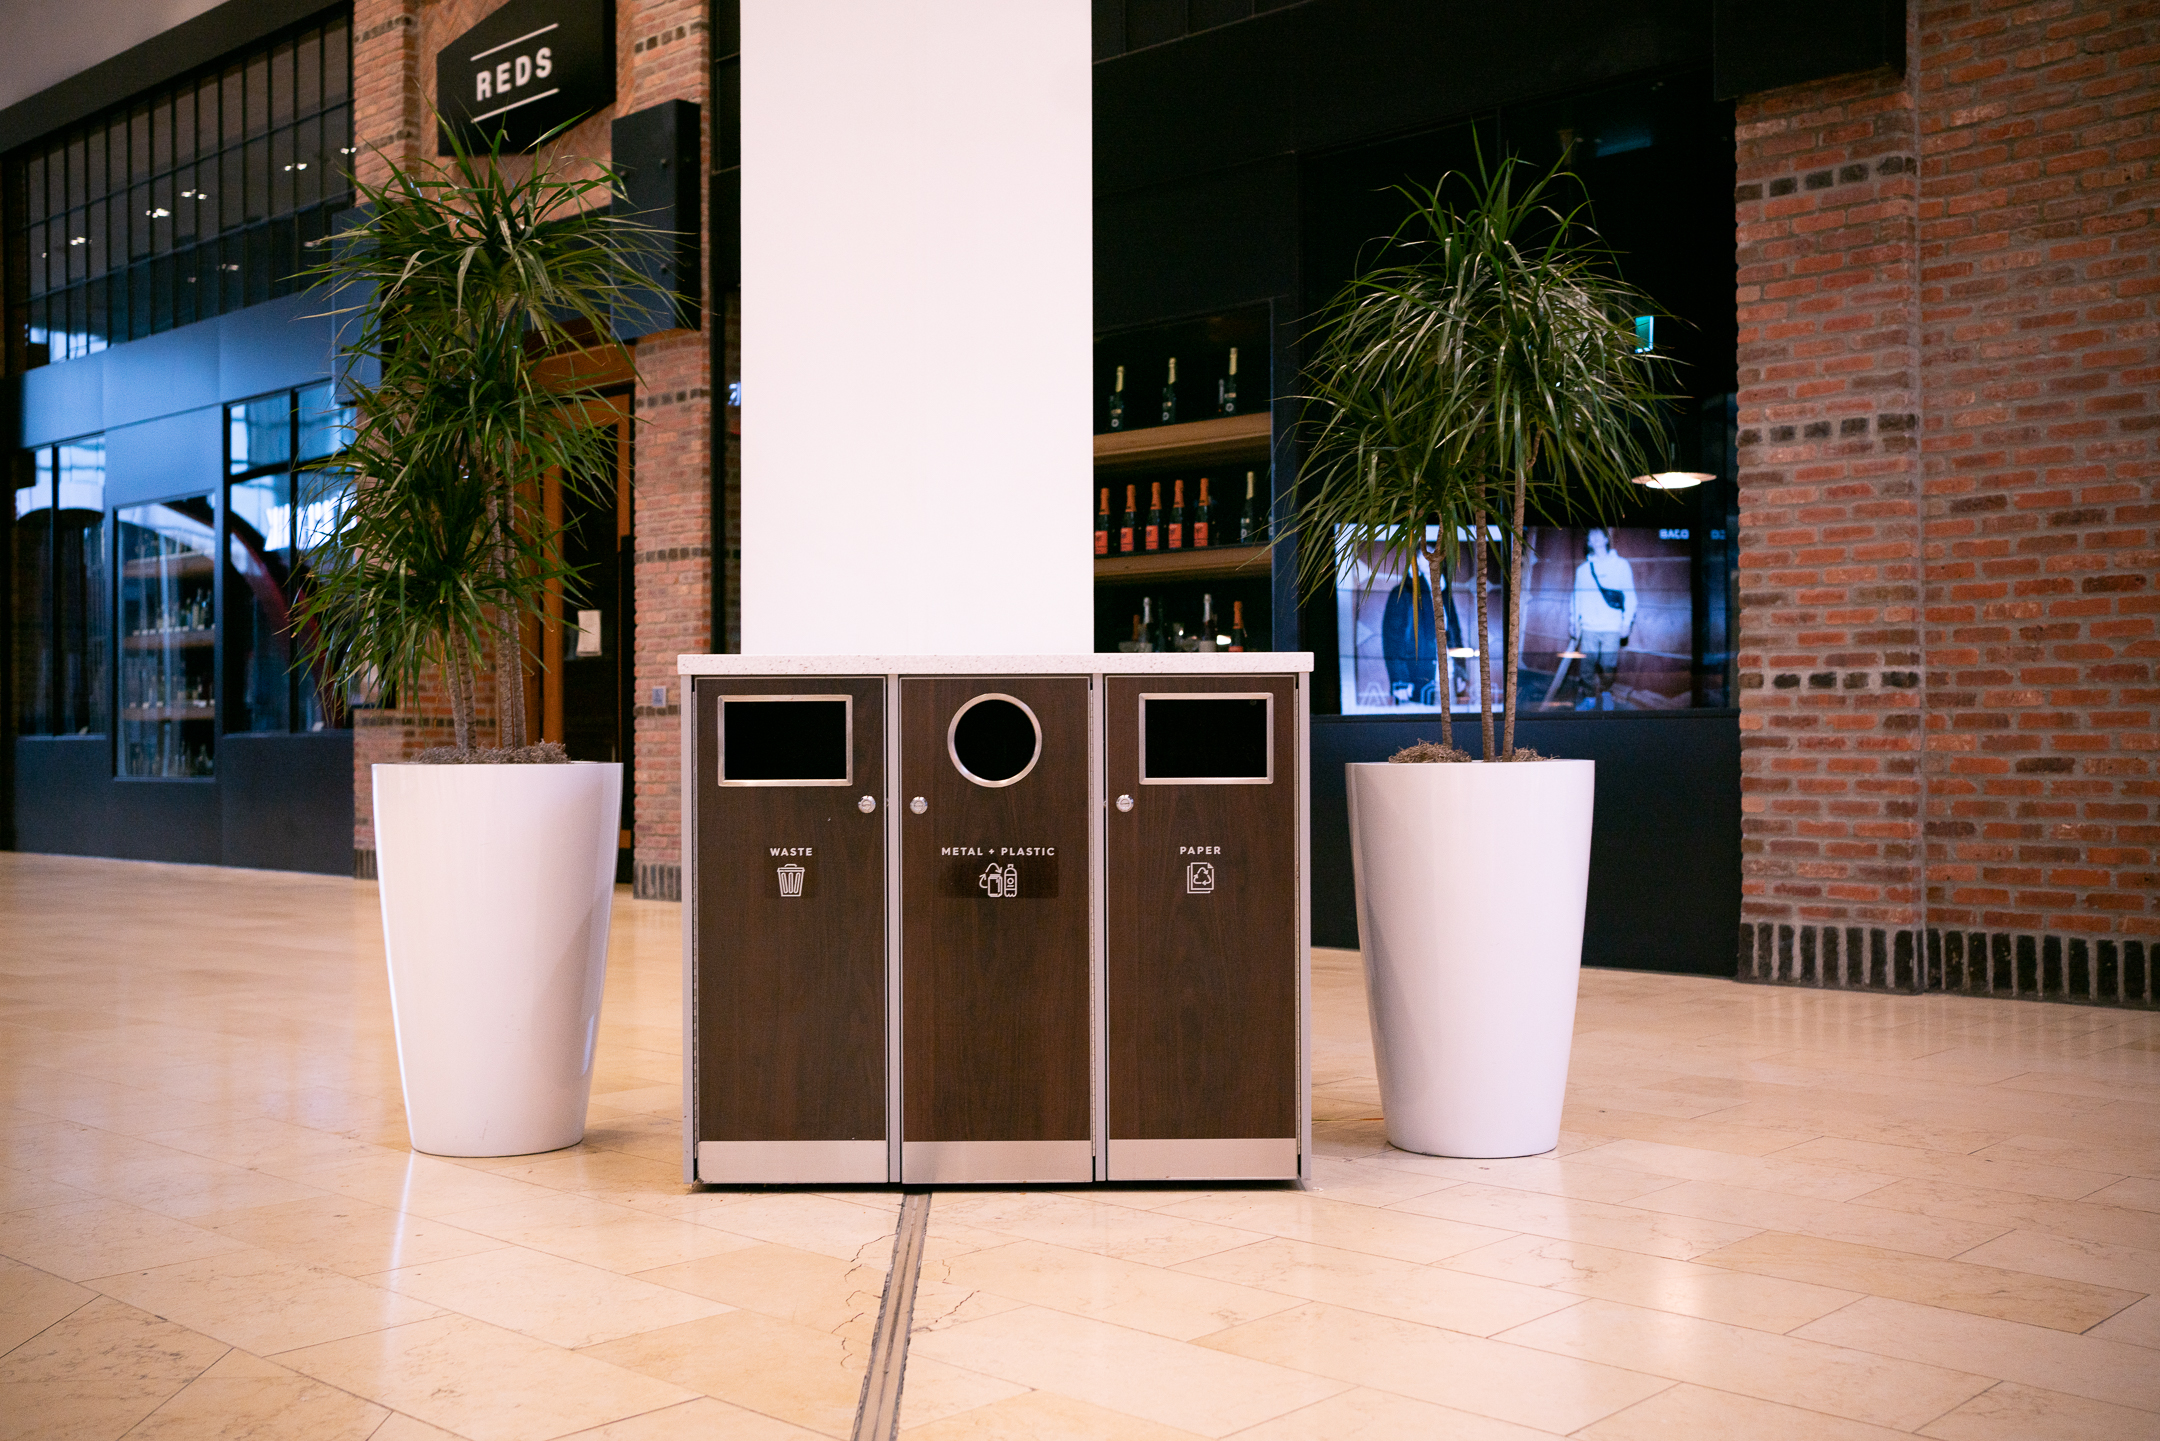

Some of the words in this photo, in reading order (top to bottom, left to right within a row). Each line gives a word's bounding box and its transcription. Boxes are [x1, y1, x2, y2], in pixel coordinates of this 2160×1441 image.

[476, 47, 552, 102] REDS
[769, 847, 813, 857] WASTE
[941, 847, 983, 856] METAL
[1001, 847, 1055, 856] PLASTIC
[1179, 846, 1221, 855] PAPER
